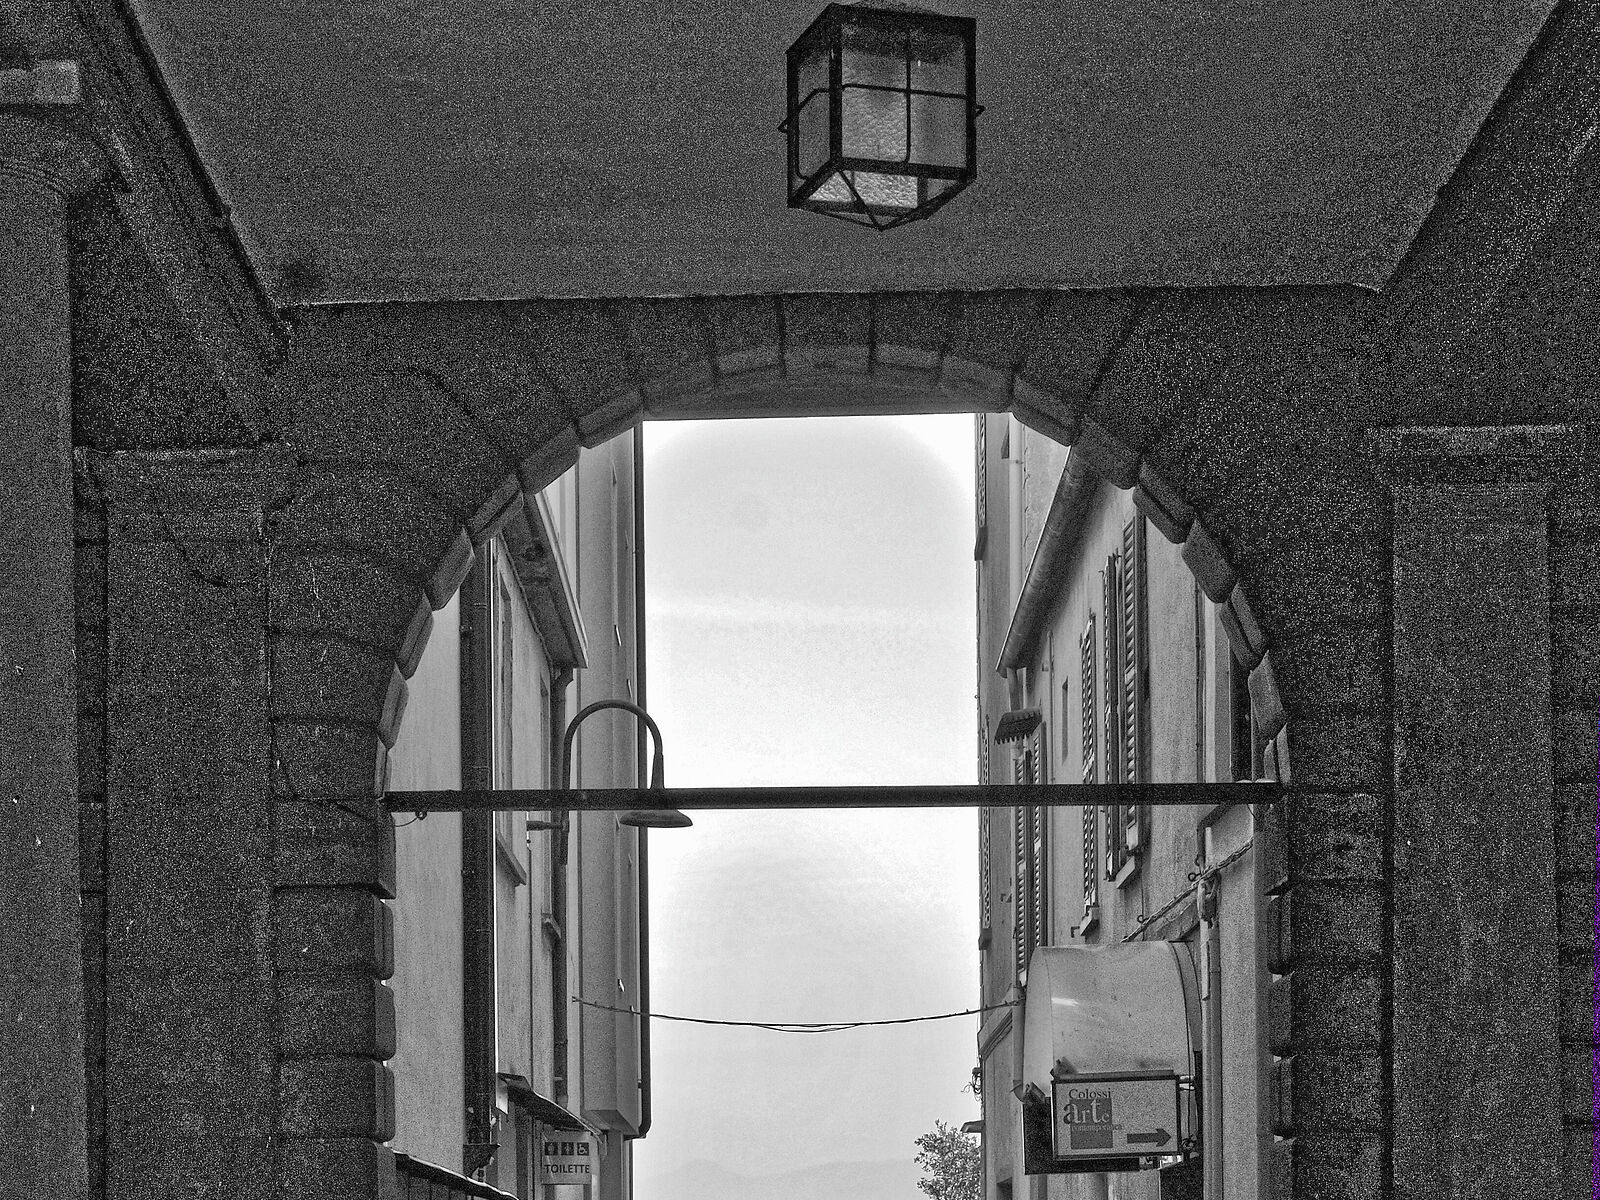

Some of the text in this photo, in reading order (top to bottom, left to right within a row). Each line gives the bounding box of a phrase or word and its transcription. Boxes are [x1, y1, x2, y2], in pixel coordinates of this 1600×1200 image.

[1068, 1088, 1111, 1100] Colossi
[1063, 1099, 1110, 1124] arte
[544, 1164, 590, 1174] TOILETTE
